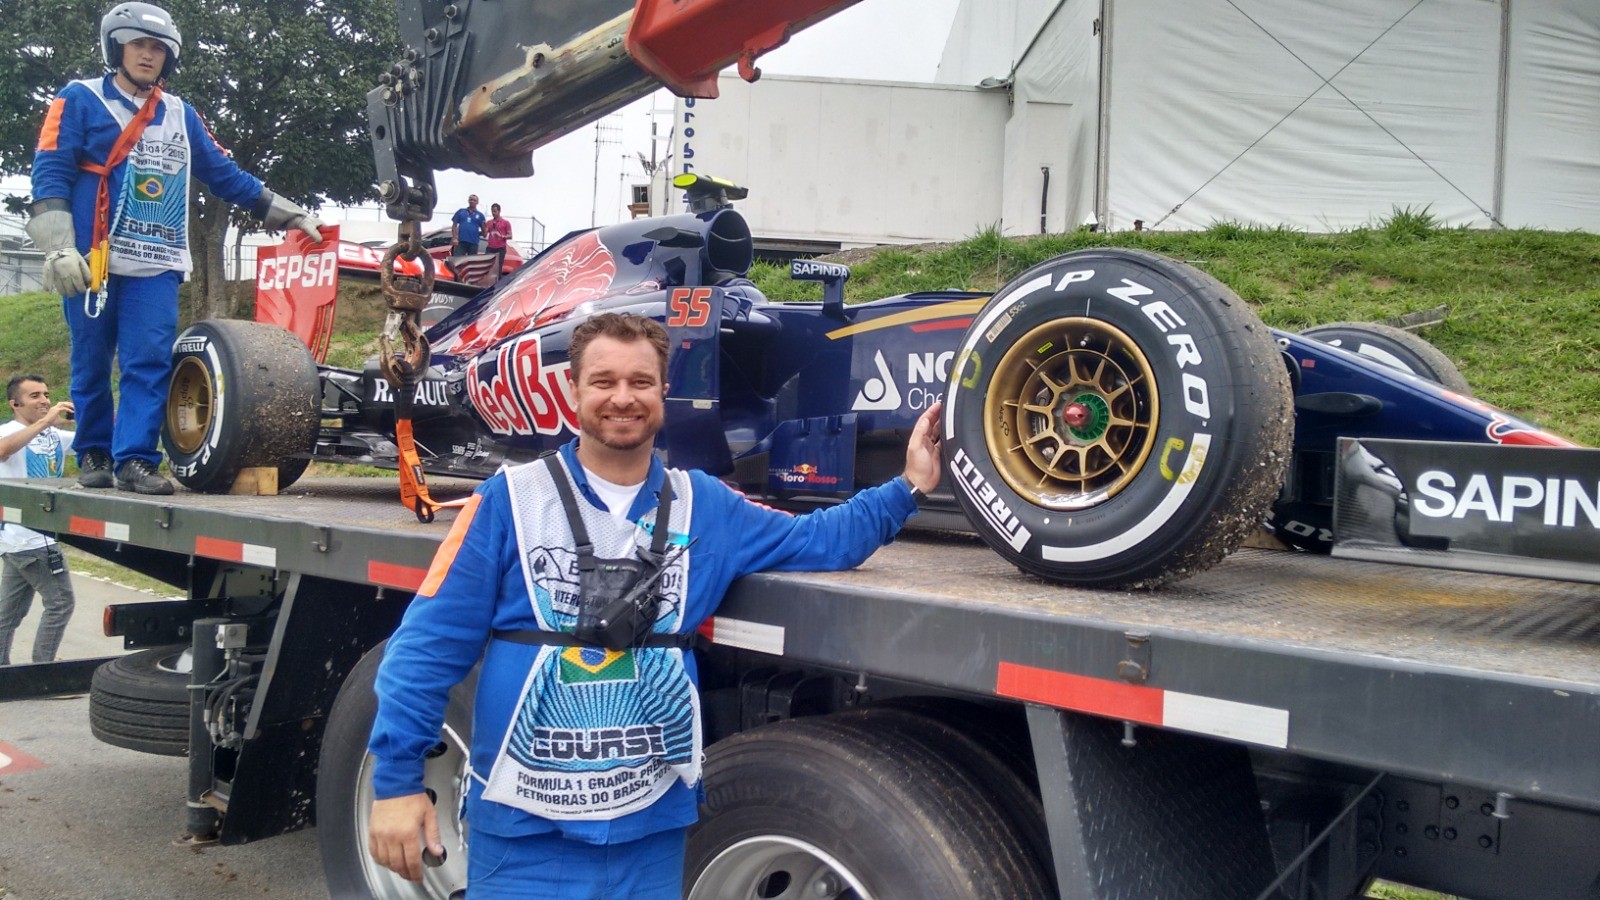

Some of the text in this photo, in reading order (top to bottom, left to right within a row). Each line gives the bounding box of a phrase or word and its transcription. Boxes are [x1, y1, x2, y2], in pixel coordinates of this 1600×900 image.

[168, 148, 185, 160] 2015
[258, 251, 337, 291] CEPSA
[792, 263, 848, 278] SAPINDA
[668, 287, 713, 327] 55
[1055, 269, 1211, 420] P ZERO
[373, 378, 450, 406] RAULT
[467, 333, 582, 436] Red Bu
[782, 472, 838, 485] Toro Rosso
[950, 447, 1032, 553] PIRELLI
[532, 725, 667, 760] COURSE
[516, 785, 587, 806] PETROBRAS
[591, 792, 609, 805] DO
[613, 780, 652, 801] BRASIL
[517, 771, 573, 791] FORMULA
[576, 780, 583, 791] 1
[588, 771, 637, 790] GRANDE
